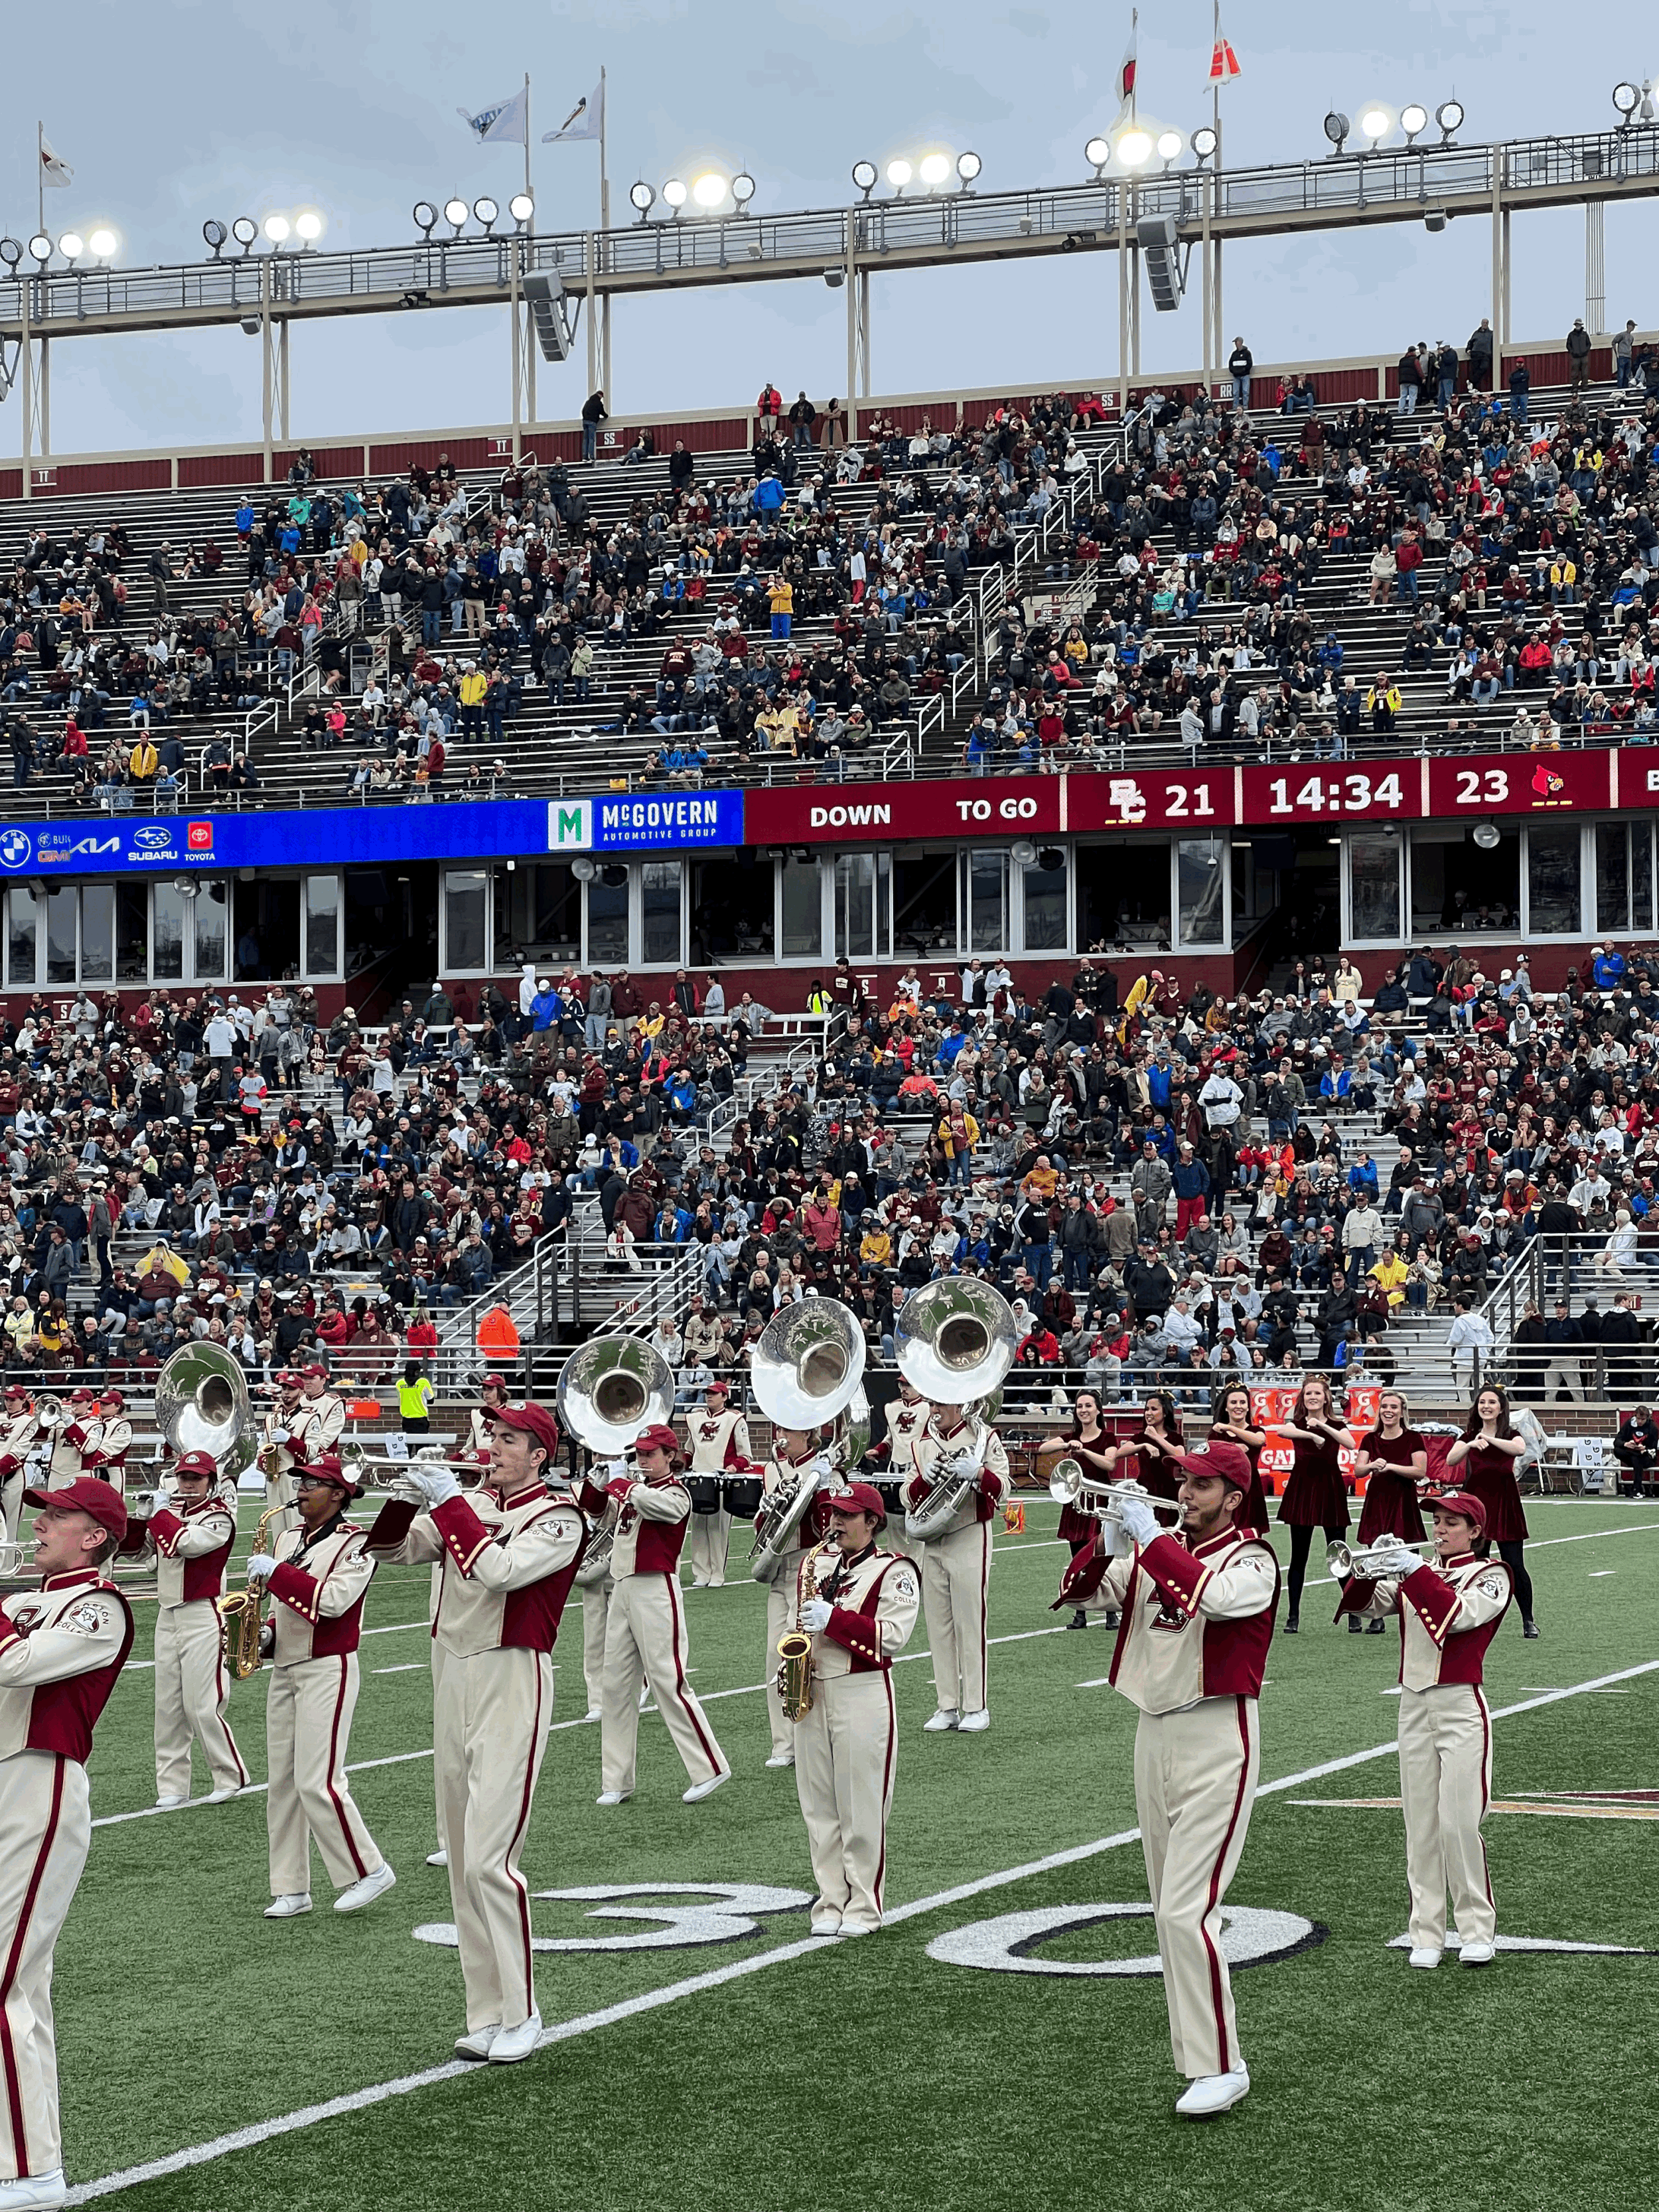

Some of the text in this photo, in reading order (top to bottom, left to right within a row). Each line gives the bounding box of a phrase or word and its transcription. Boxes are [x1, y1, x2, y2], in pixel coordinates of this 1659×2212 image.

[1220, 384, 1232, 398] RR
[1102, 394, 1114, 406] SS
[604, 432, 615, 445] SS
[496, 440, 506, 452] TT
[38, 470, 48, 482] TT
[1270, 773, 1403, 813] 14:34
[1457, 770, 1508, 804] 23
[1165, 784, 1214, 816] 21
[810, 804, 891, 827] DOWN
[956, 798, 1037, 821] TO GO
[558, 808, 582, 842] M
[603, 829, 717, 842] AUTOMOTIVE GROUP
[127, 851, 178, 861] SUBARU
[184, 853, 216, 861] TOYOTA
[60, 1004, 67, 1019] S
[1254, 1393, 1266, 1406] G
[1281, 1394, 1293, 1408] G
[1358, 1392, 1370, 1406] G
